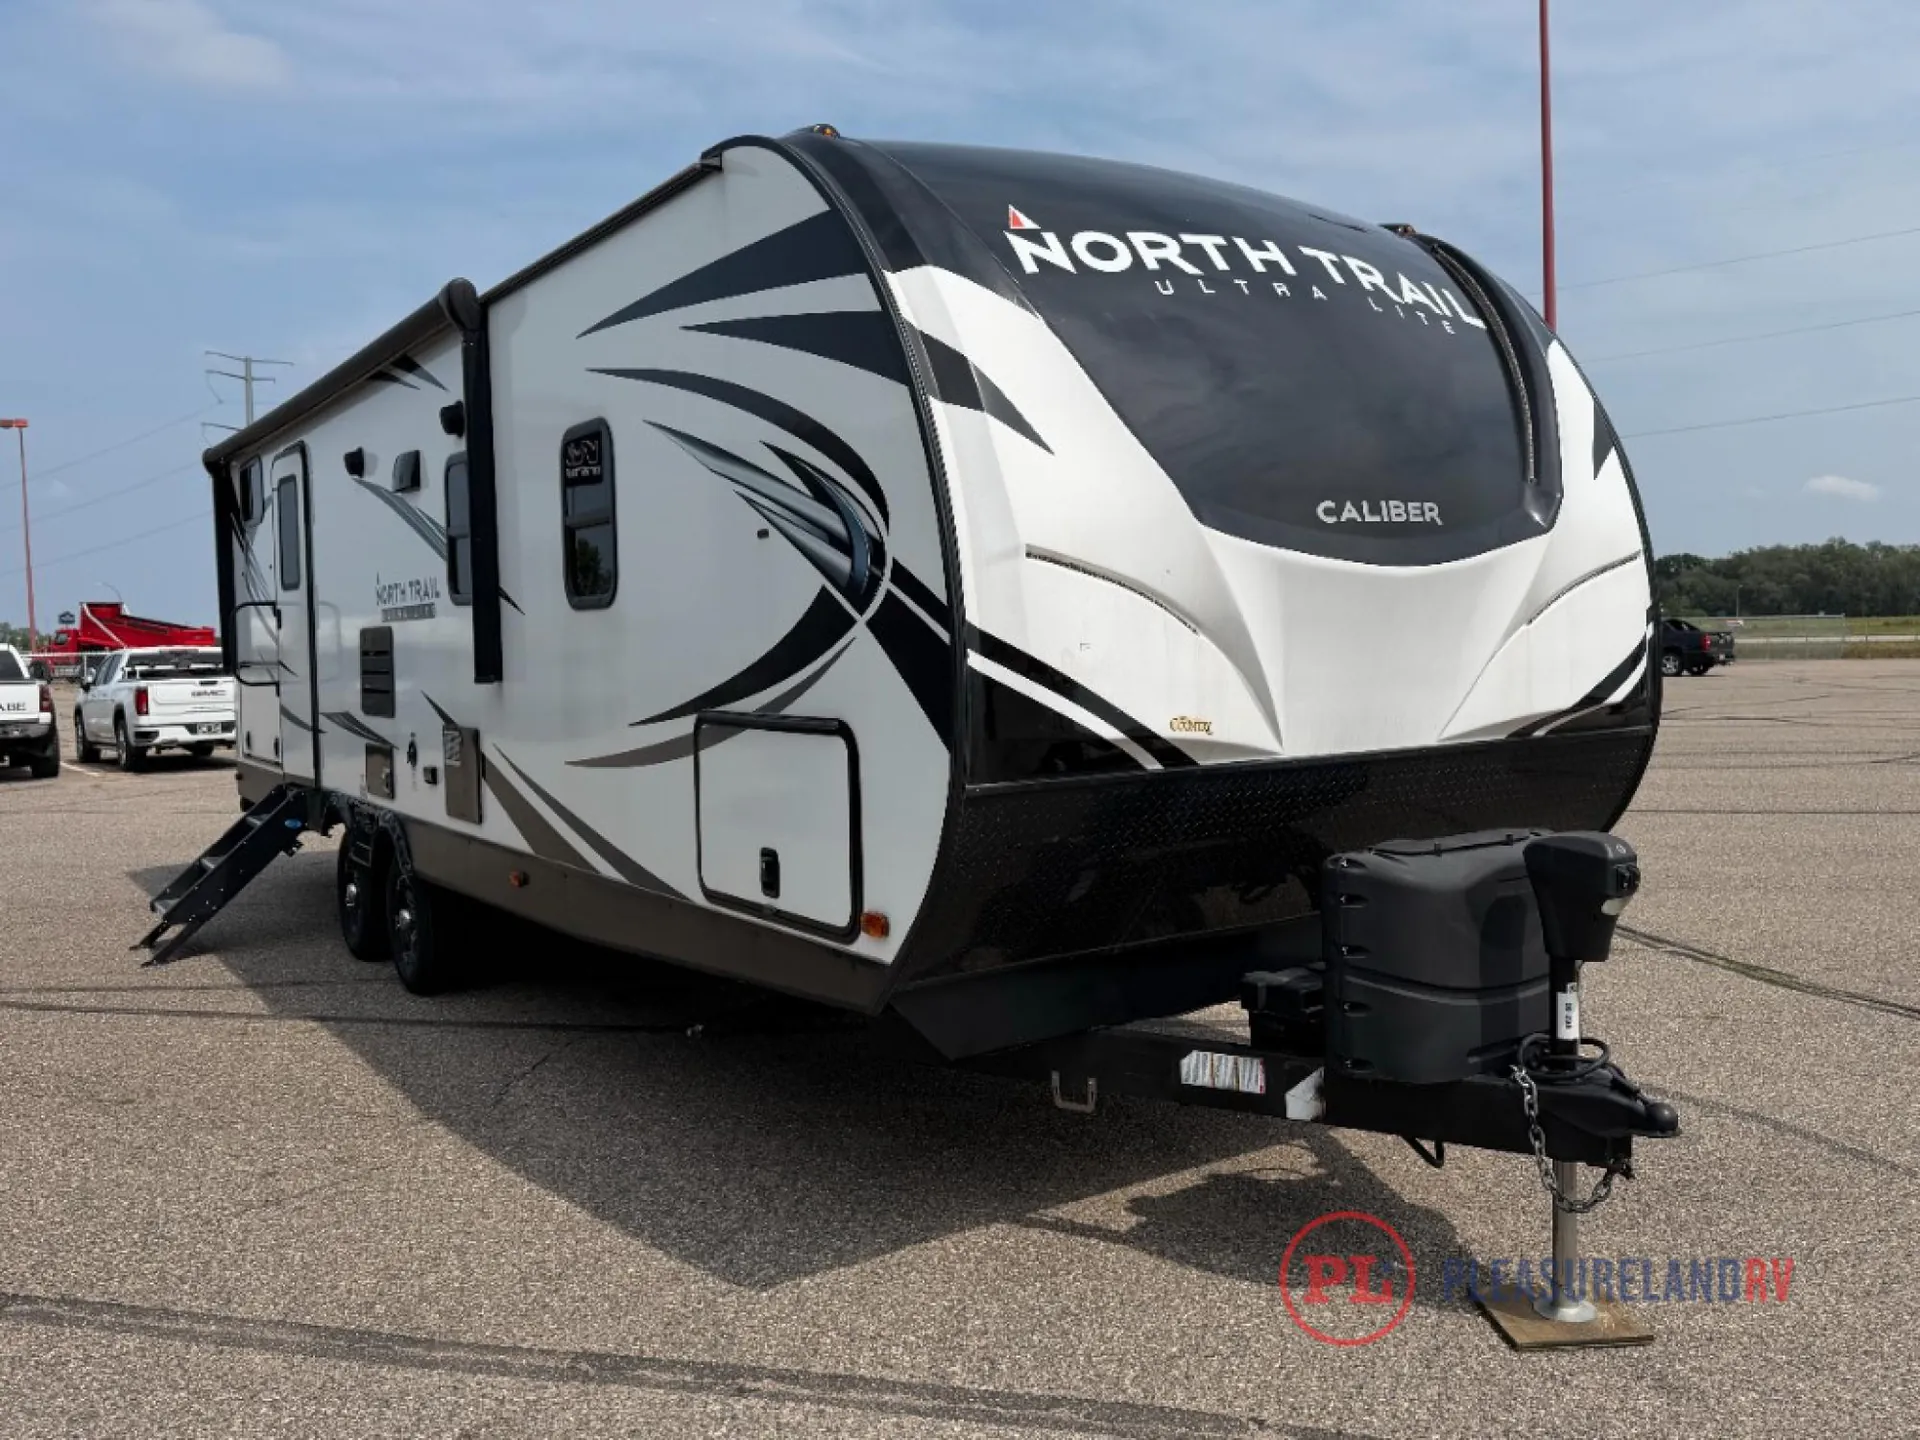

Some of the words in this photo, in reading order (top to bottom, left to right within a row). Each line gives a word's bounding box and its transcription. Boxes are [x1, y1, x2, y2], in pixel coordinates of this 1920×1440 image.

[1003, 229, 1297, 276] NORTH
[1298, 245, 1487, 330] TRAIL
[1154, 278, 1328, 300] ULTRA
[1367, 297, 1456, 335] LITE
[1315, 500, 1444, 526] CALIBER
[375, 581, 406, 607] NORTH
[408, 576, 441, 602] TRAIL
